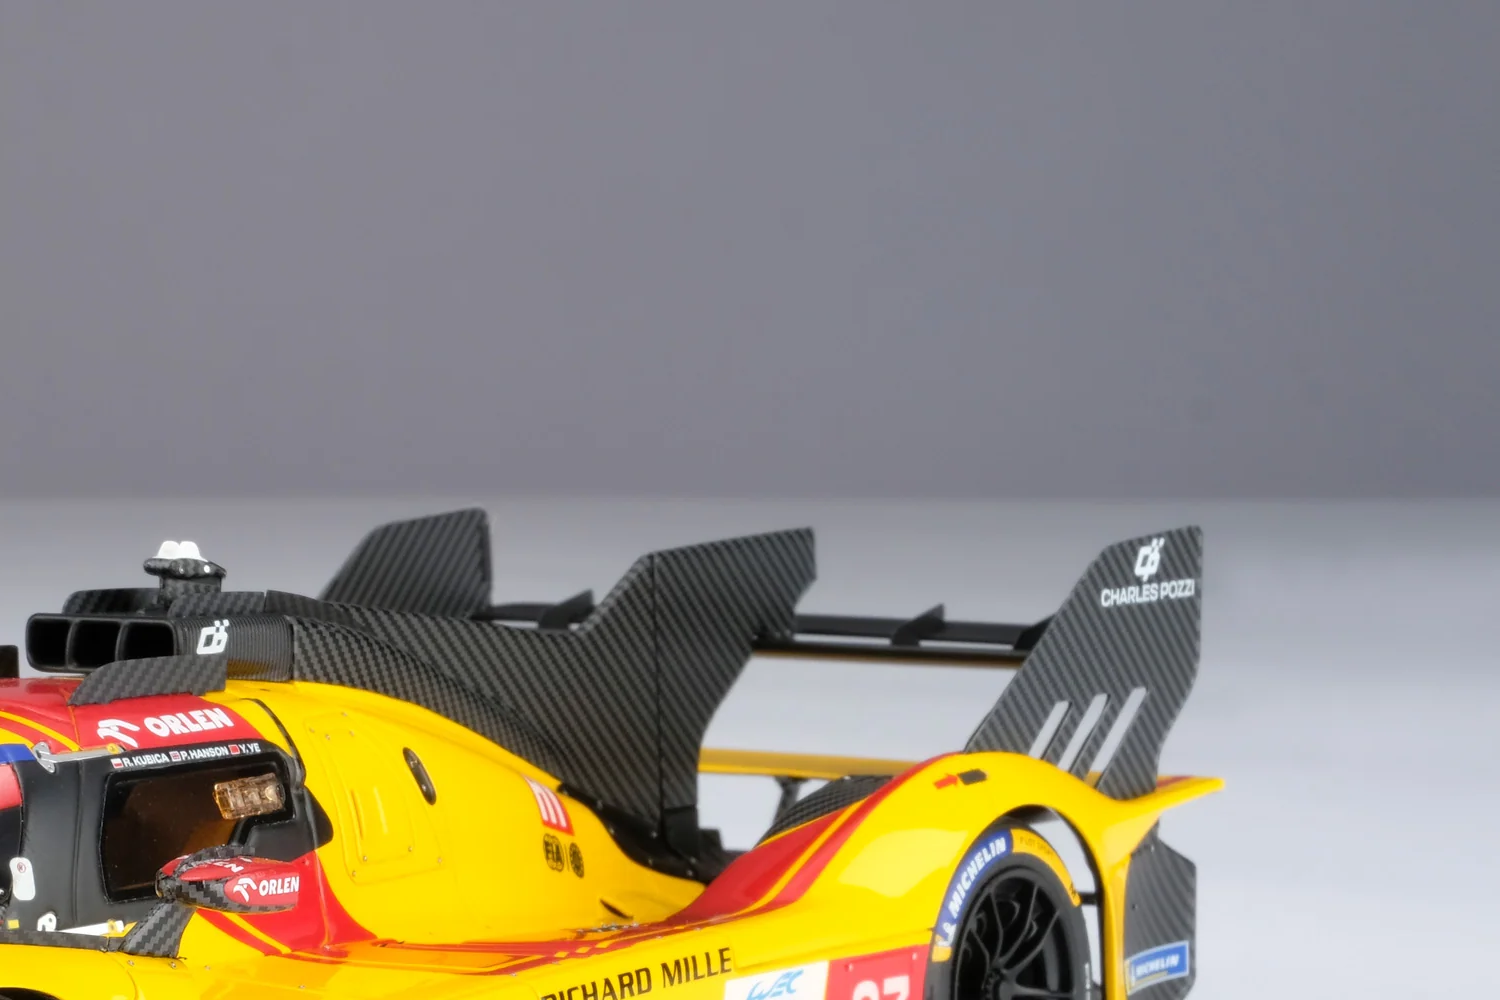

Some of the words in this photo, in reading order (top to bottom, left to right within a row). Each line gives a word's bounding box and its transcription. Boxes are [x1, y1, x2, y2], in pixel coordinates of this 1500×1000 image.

[1101, 582, 1159, 607] CHARLES
[1160, 578, 1195, 600] POZZI
[143, 707, 235, 738] ORLEN
[258, 875, 300, 897] ORLEN
[947, 836, 1007, 920] MICHELIN
[660, 947, 733, 989] MILLE
